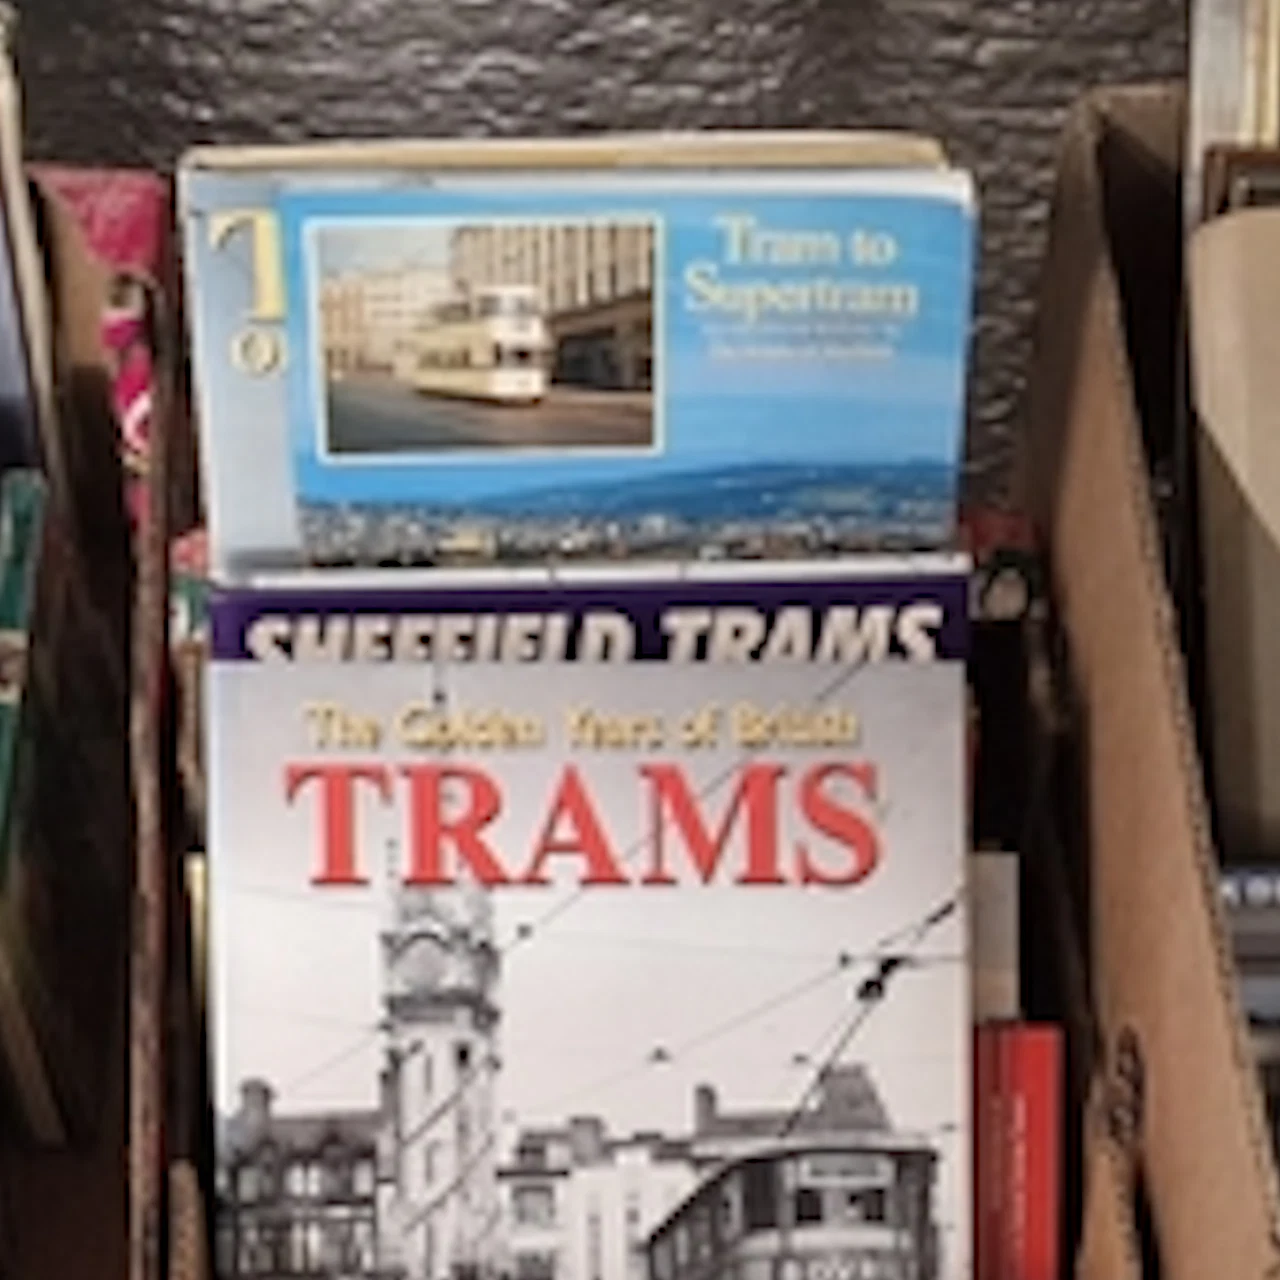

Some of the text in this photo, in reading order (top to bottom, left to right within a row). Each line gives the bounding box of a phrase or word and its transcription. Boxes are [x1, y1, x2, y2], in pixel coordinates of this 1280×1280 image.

[710, 213, 897, 266] Tram to
[684, 259, 918, 326] Supertram
[244, 606, 944, 662] SHEFFIELD TRAMS
[304, 703, 860, 749] The Golden Years of British
[283, 760, 888, 888] TRAMS
